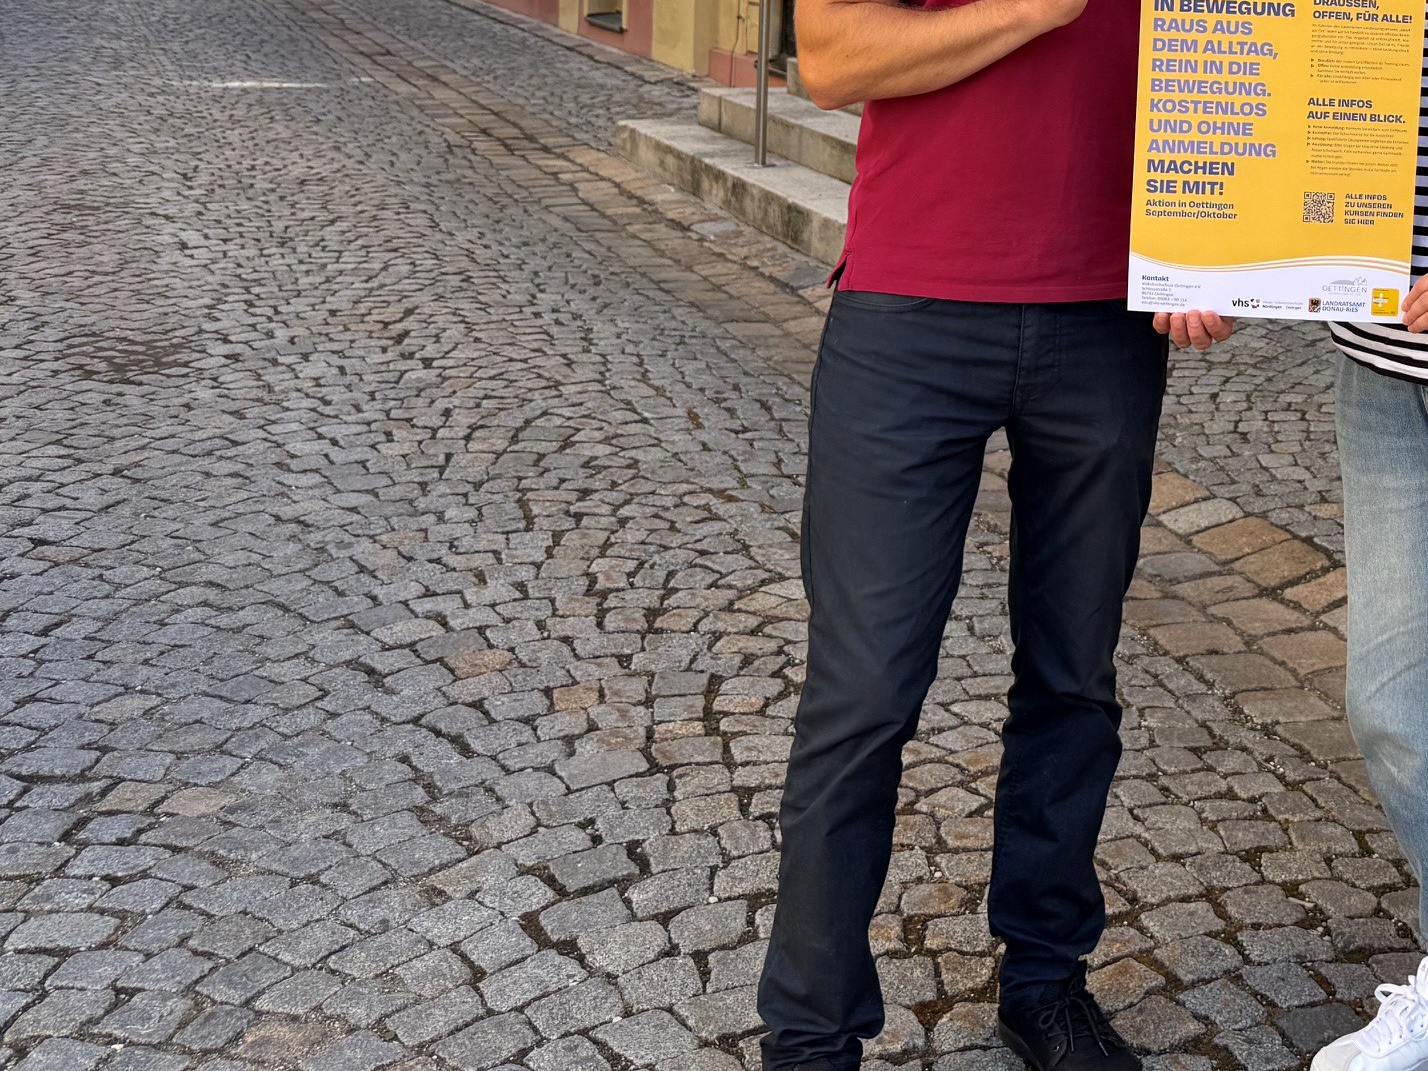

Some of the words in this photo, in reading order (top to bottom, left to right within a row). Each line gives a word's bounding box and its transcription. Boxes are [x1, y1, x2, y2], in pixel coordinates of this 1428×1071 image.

[1313, 10, 1353, 22] OFFEN,
[1356, 11, 1378, 22] FÜR
[1381, 14, 1412, 23] ALLE!
[1153, 17, 1208, 34] RAUS
[1212, 20, 1253, 36] AUS
[1152, 38, 1198, 53] DEM
[1202, 39, 1278, 60] ALLTAG,
[1151, 58, 1198, 73] REIN
[1203, 60, 1223, 75] IN
[1228, 61, 1260, 76] DIE
[1150, 78, 1272, 97] BEWEGUNG.
[1150, 98, 1267, 117] KOSTENLOS
[1307, 98, 1335, 107] ALLE
[1338, 99, 1373, 109] INFOS
[1307, 111, 1330, 120] AUF
[1332, 112, 1367, 122] EINEN
[1369, 114, 1406, 123] BLICK.
[1149, 119, 1192, 134] UND
[1197, 120, 1254, 137] OHNE
[1147, 138, 1277, 158] ANMELDUNG
[1146, 159, 1235, 176] MACHEN
[1146, 179, 1177, 194] SIE
[1182, 180, 1224, 196] MIT!
[1145, 199, 1176, 208] Aktion
[1178, 200, 1186, 208] in
[1189, 201, 1234, 211] Oettingen
[1145, 209, 1237, 219] September/Oktober
[1232, 298, 1249, 307] vhs
